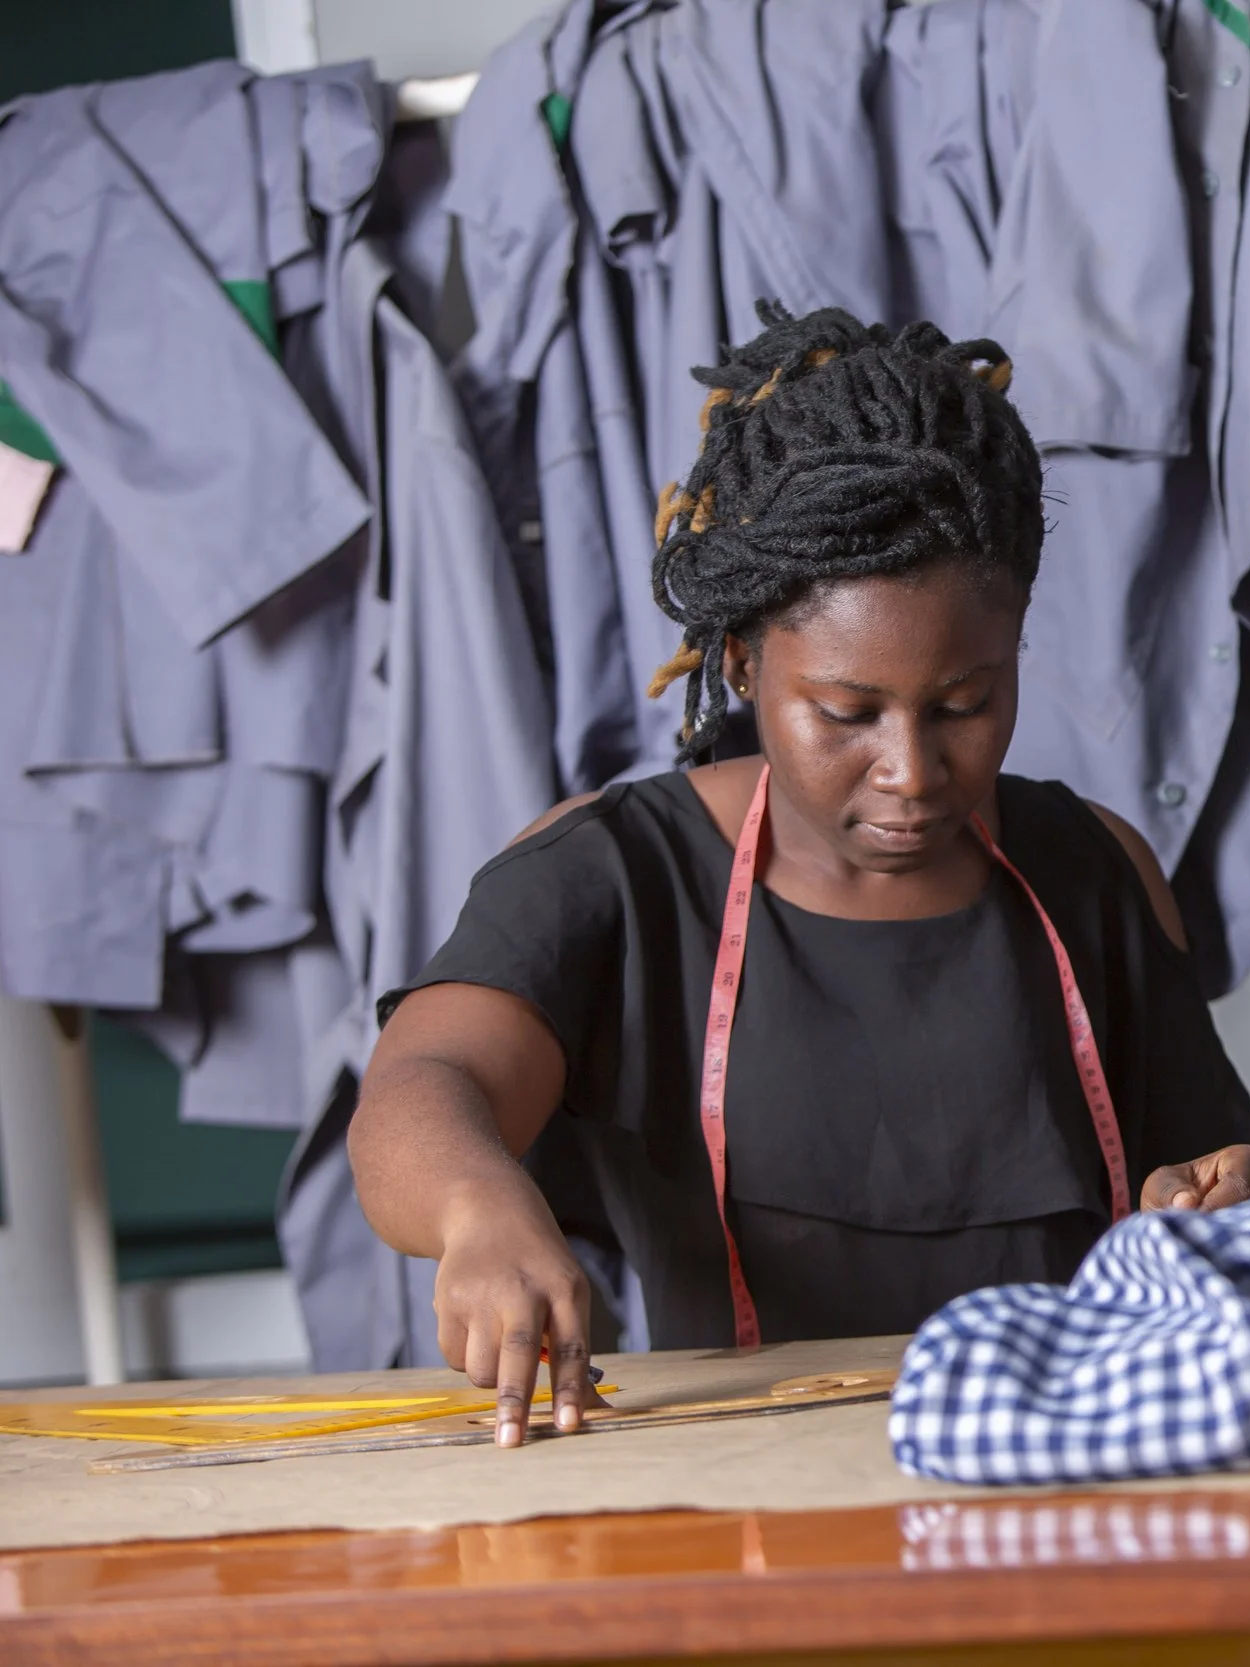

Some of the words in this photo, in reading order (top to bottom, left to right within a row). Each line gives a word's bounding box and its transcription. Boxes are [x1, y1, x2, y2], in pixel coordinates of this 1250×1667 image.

[717, 1014, 728, 1028] 19
[723, 971, 735, 987] 20
[730, 934, 741, 947] 21
[736, 890, 747, 905] 22
